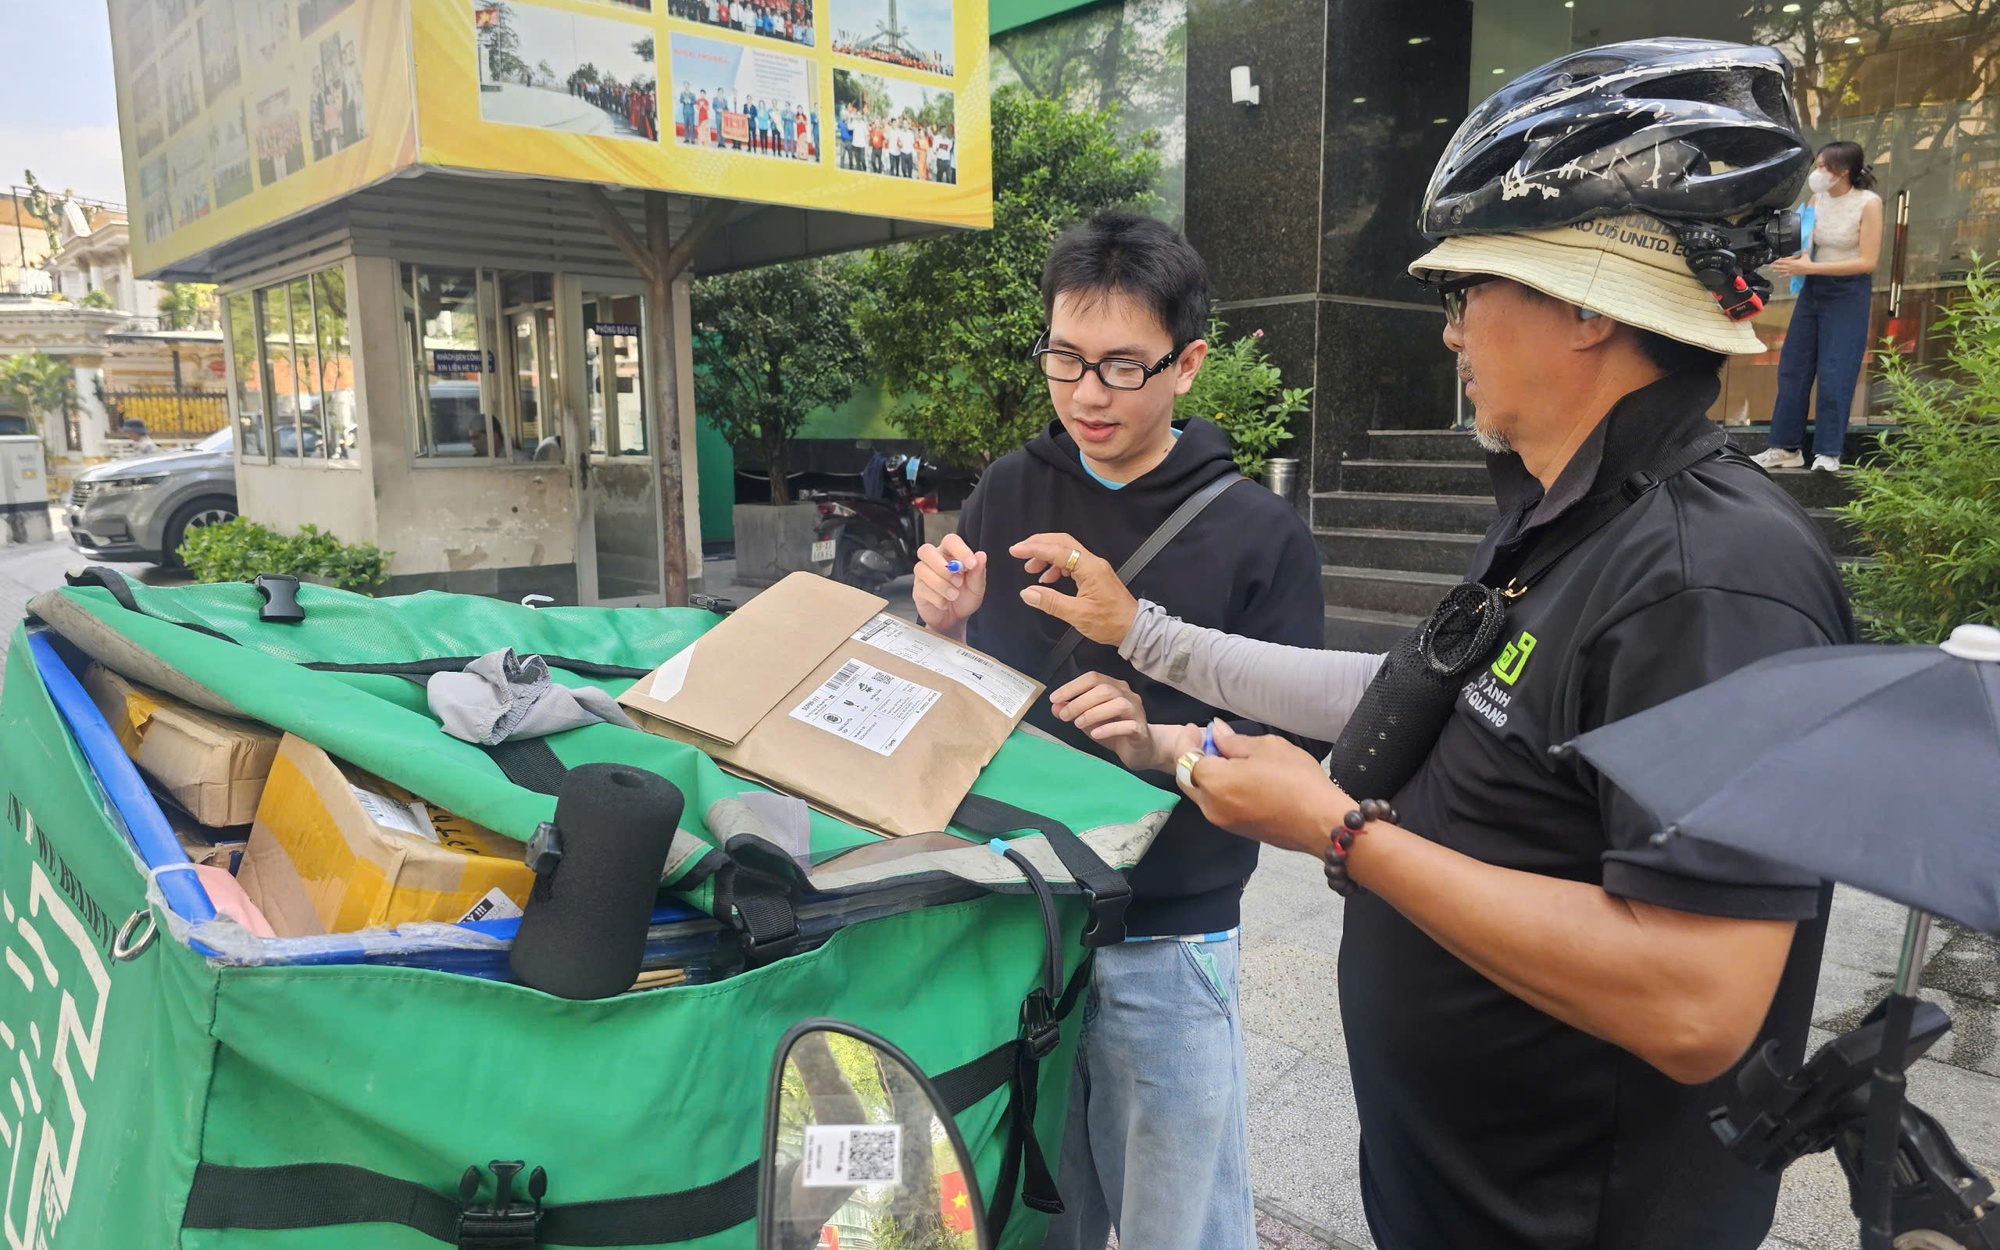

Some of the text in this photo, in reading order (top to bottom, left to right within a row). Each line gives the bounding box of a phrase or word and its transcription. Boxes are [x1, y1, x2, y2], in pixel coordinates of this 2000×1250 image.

[1619, 230, 1669, 253] UNLTD.
[1468, 691, 1508, 727] QUANG
[1483, 677, 1512, 708] ẢNH
[36, 823, 57, 877] WE
